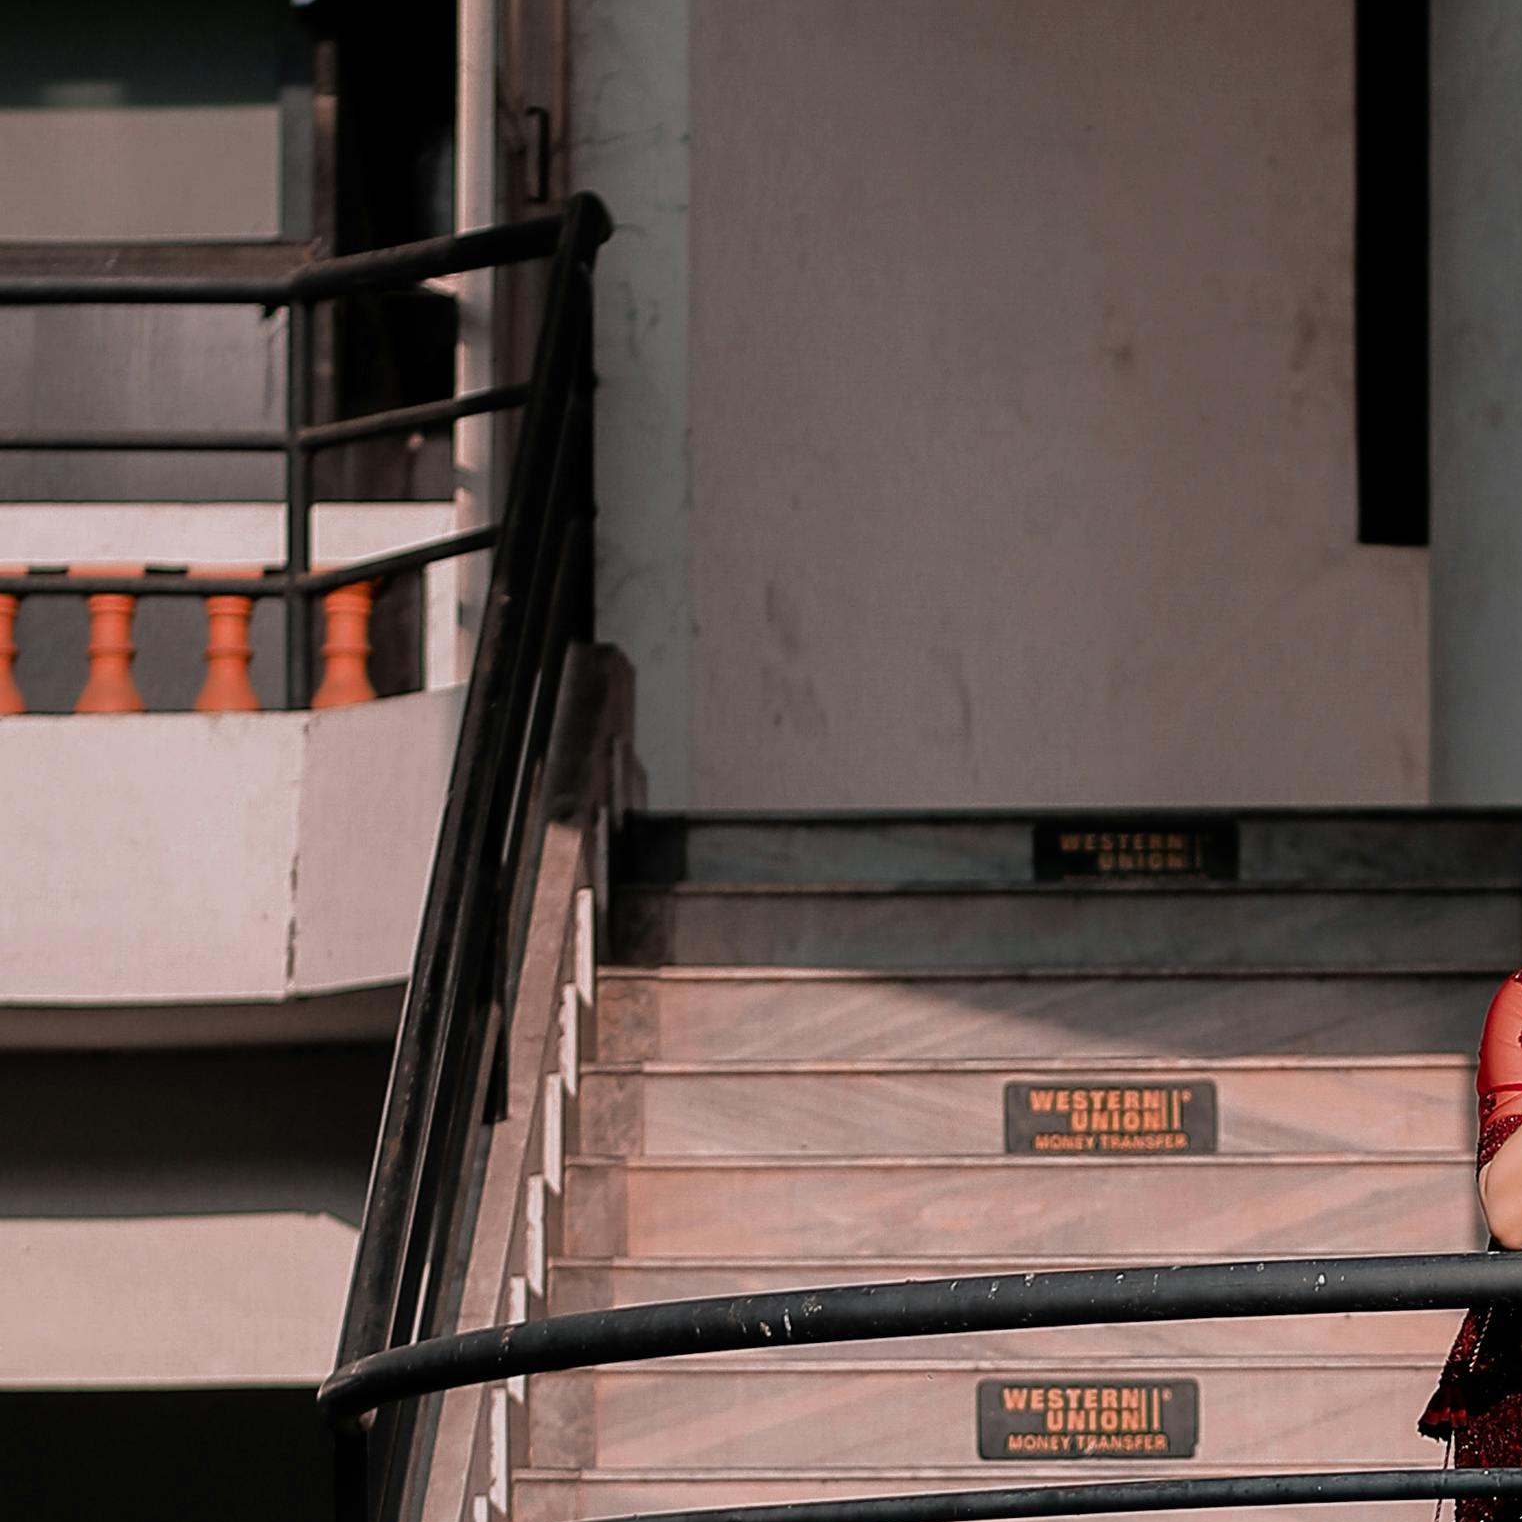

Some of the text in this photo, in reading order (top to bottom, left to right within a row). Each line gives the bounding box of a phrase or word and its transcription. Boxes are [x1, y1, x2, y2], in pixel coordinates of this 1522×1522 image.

[1030, 1089, 1160, 1112] WESTERN
[1071, 1111, 1160, 1132] UNION
[1035, 1134, 1188, 1151] MONEY TRANSFER
[1003, 1388, 1139, 1410] WESTERN
[1046, 1410, 1139, 1430] UNION
[1008, 1435, 1167, 1451] MONEY TRANSFER
